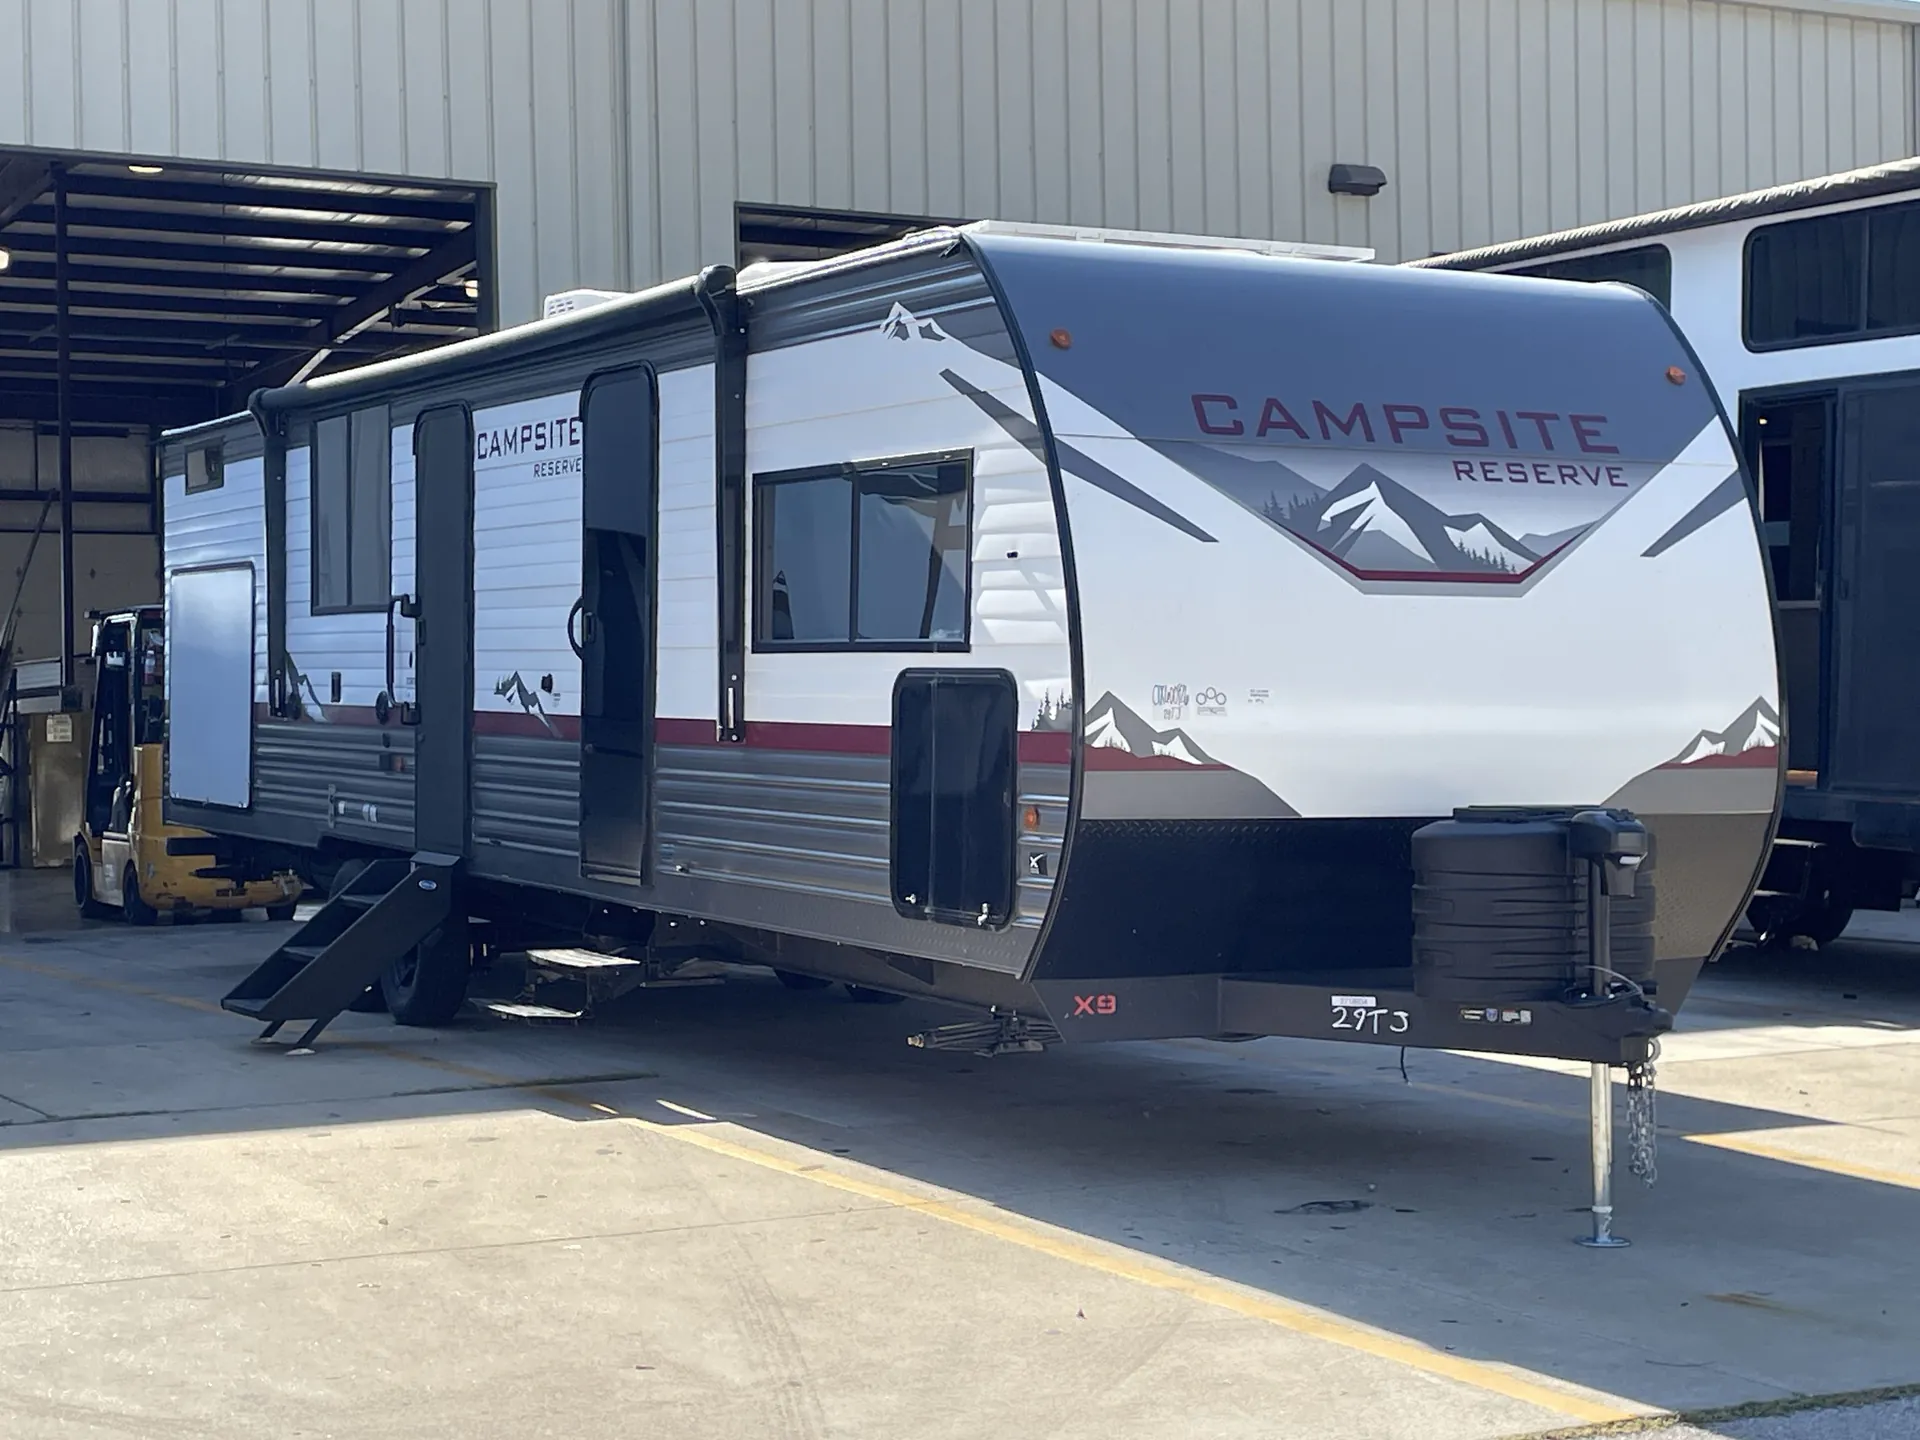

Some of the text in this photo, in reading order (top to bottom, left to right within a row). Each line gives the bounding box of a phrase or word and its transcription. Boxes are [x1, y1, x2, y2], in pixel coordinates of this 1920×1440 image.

[477, 416, 581, 459] CAMPSITE
[1191, 393, 1620, 454] CAMPSITE
[533, 457, 582, 478] RESERVE
[1452, 460, 1629, 488] RESERVE
